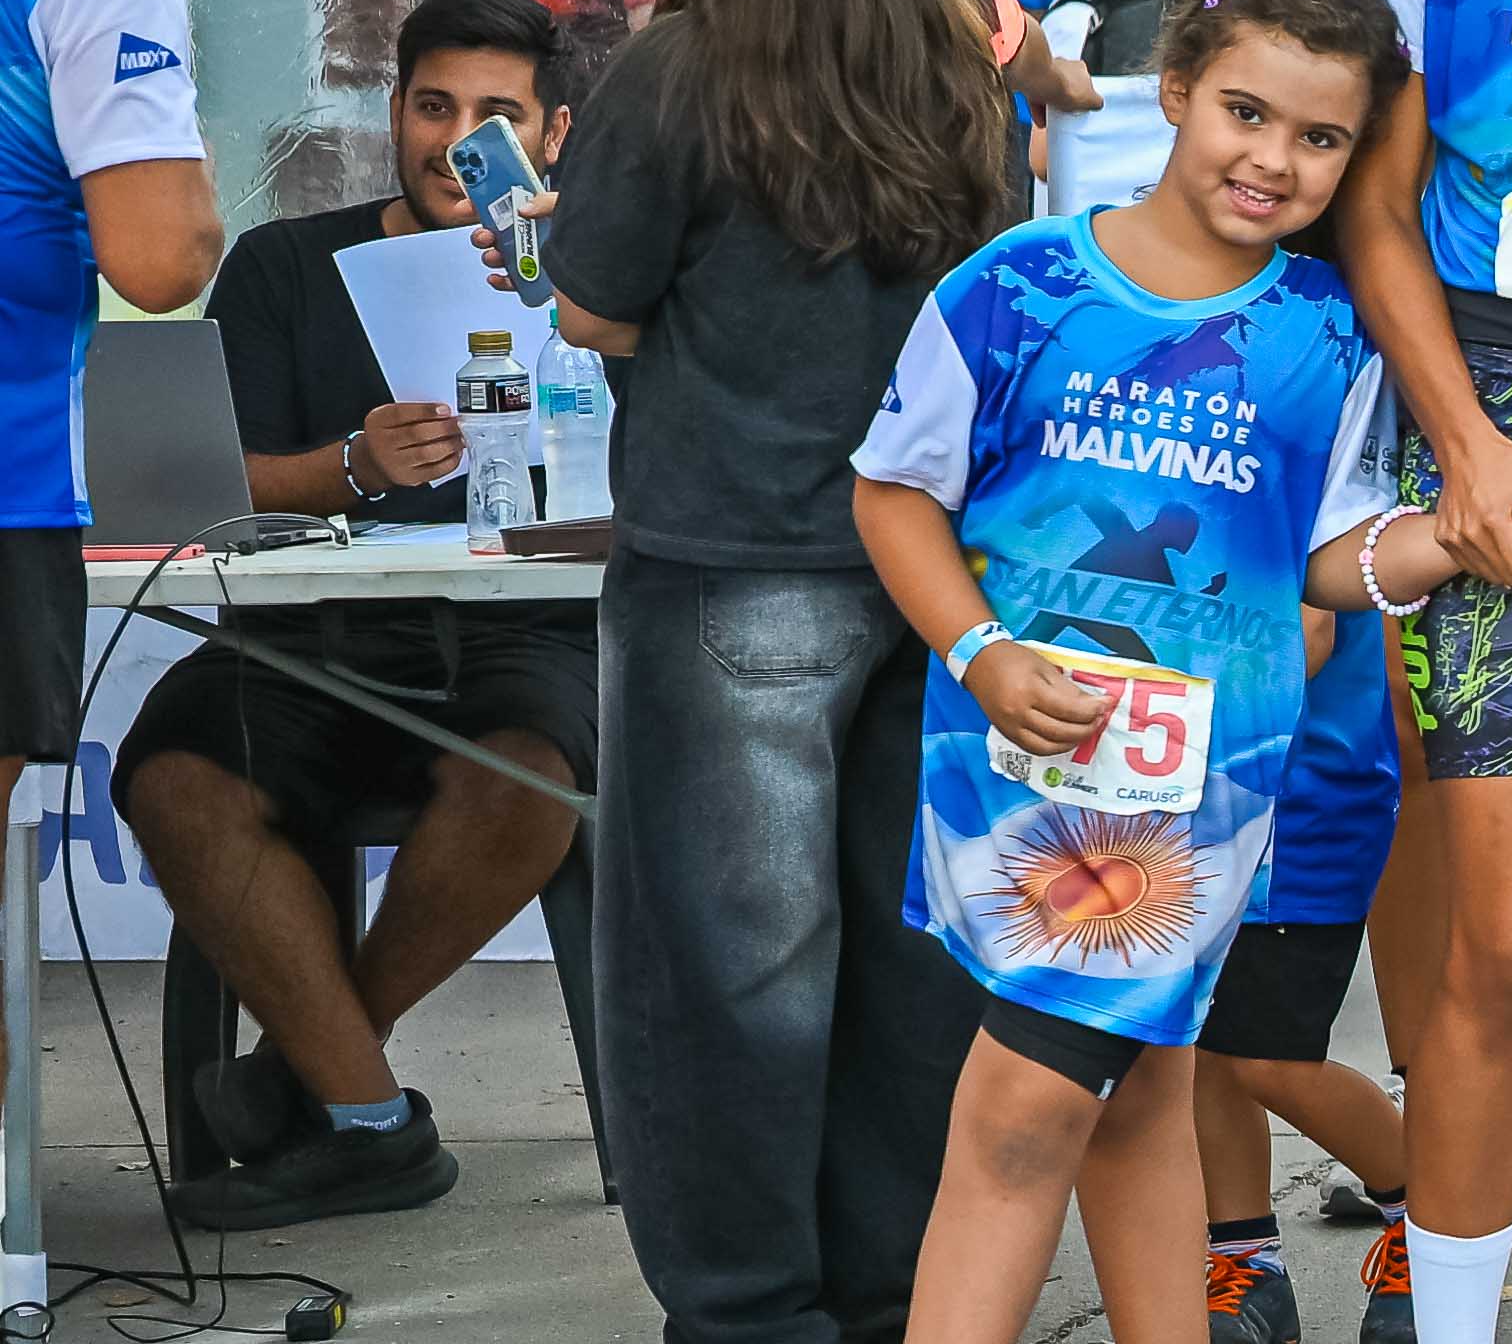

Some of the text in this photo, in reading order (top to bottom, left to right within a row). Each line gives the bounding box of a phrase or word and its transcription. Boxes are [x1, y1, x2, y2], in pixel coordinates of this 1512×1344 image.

[120, 46, 171, 72] MDXT
[1063, 395, 1251, 446] HÉROES DE
[1065, 370, 1258, 423] MARATÓN
[1040, 419, 1262, 494] MALVINAS
[1055, 665, 1187, 778] 75
[1115, 787, 1183, 804] CARUSO
